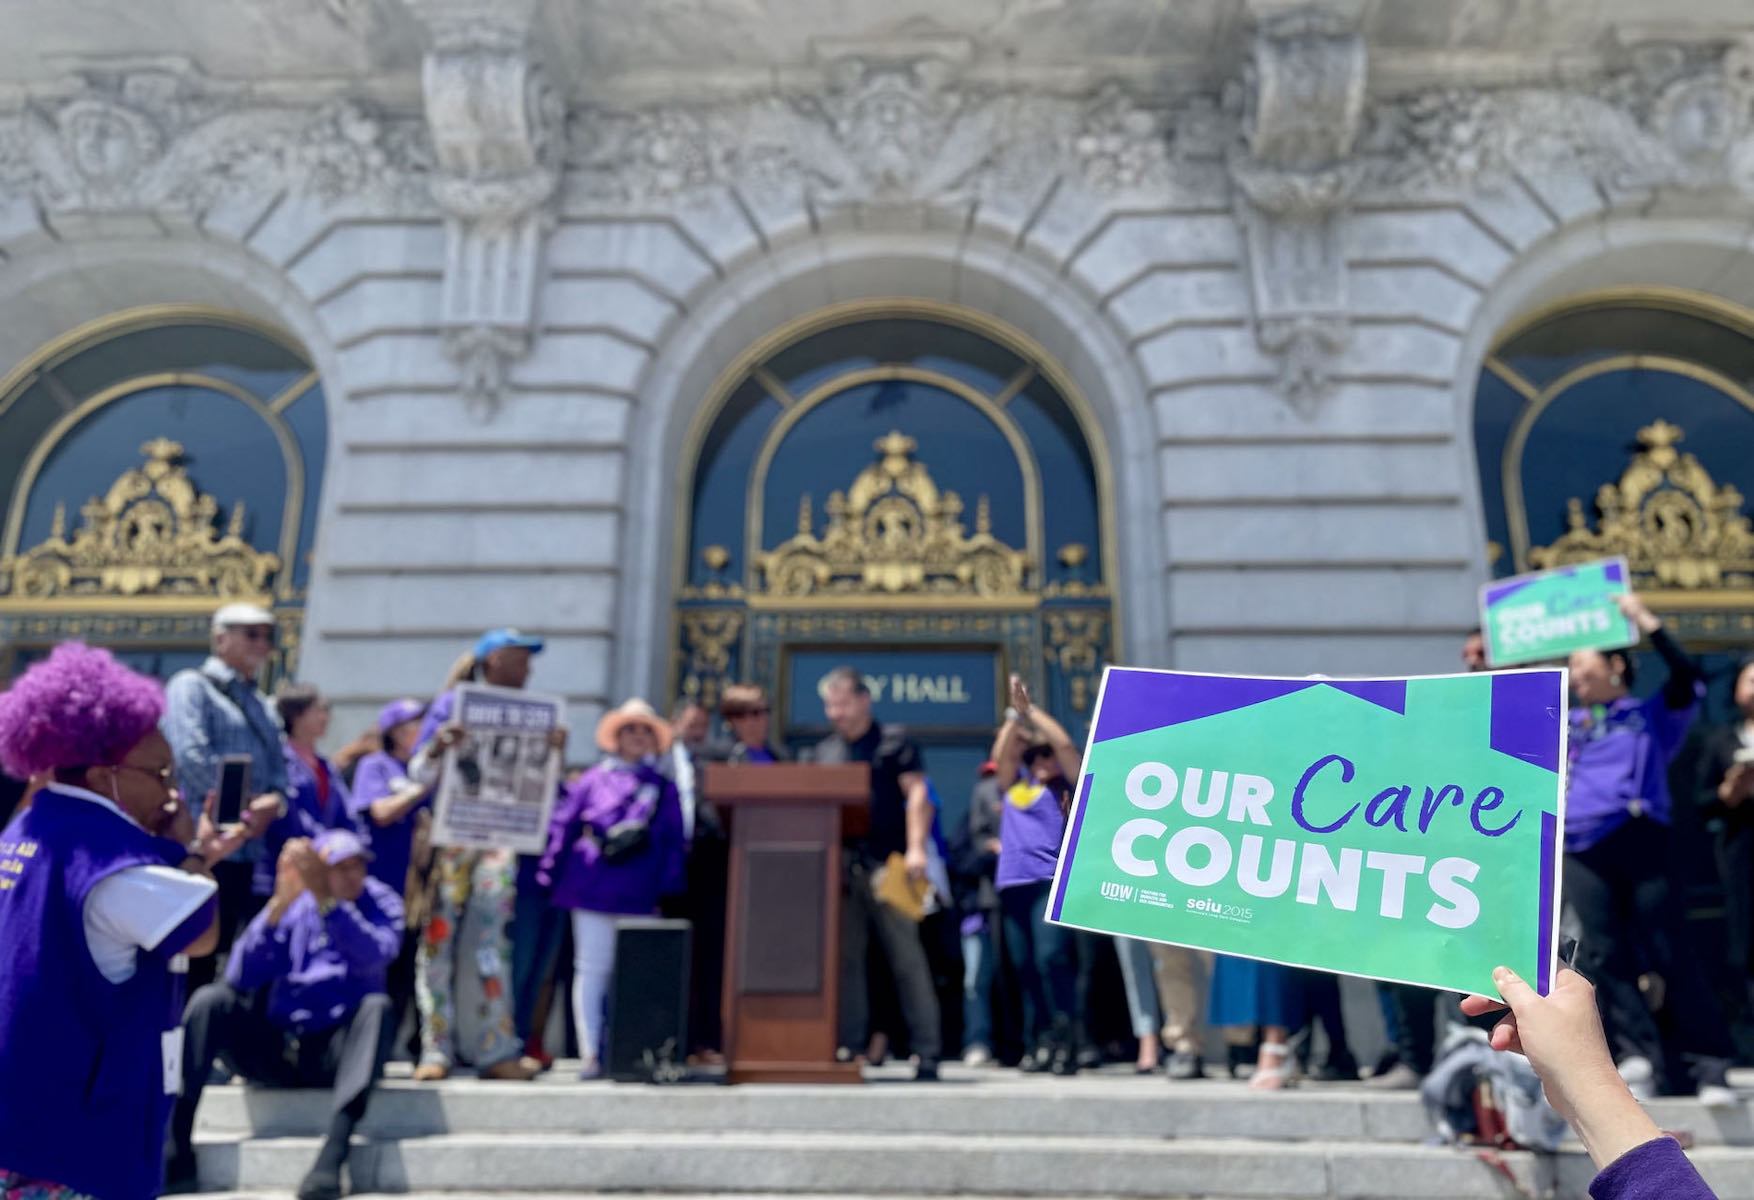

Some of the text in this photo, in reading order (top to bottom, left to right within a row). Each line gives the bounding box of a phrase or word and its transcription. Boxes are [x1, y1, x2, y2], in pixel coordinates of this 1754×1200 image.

[1499, 608, 1612, 644] COUNTS
[892, 673, 971, 703] HALL
[1124, 754, 1523, 837] OUR Care
[1111, 818, 1481, 929] COUNTS
[1100, 881, 1134, 900] UDW
[1186, 897, 1222, 914] seiu
[1223, 905, 1253, 919] 2015
